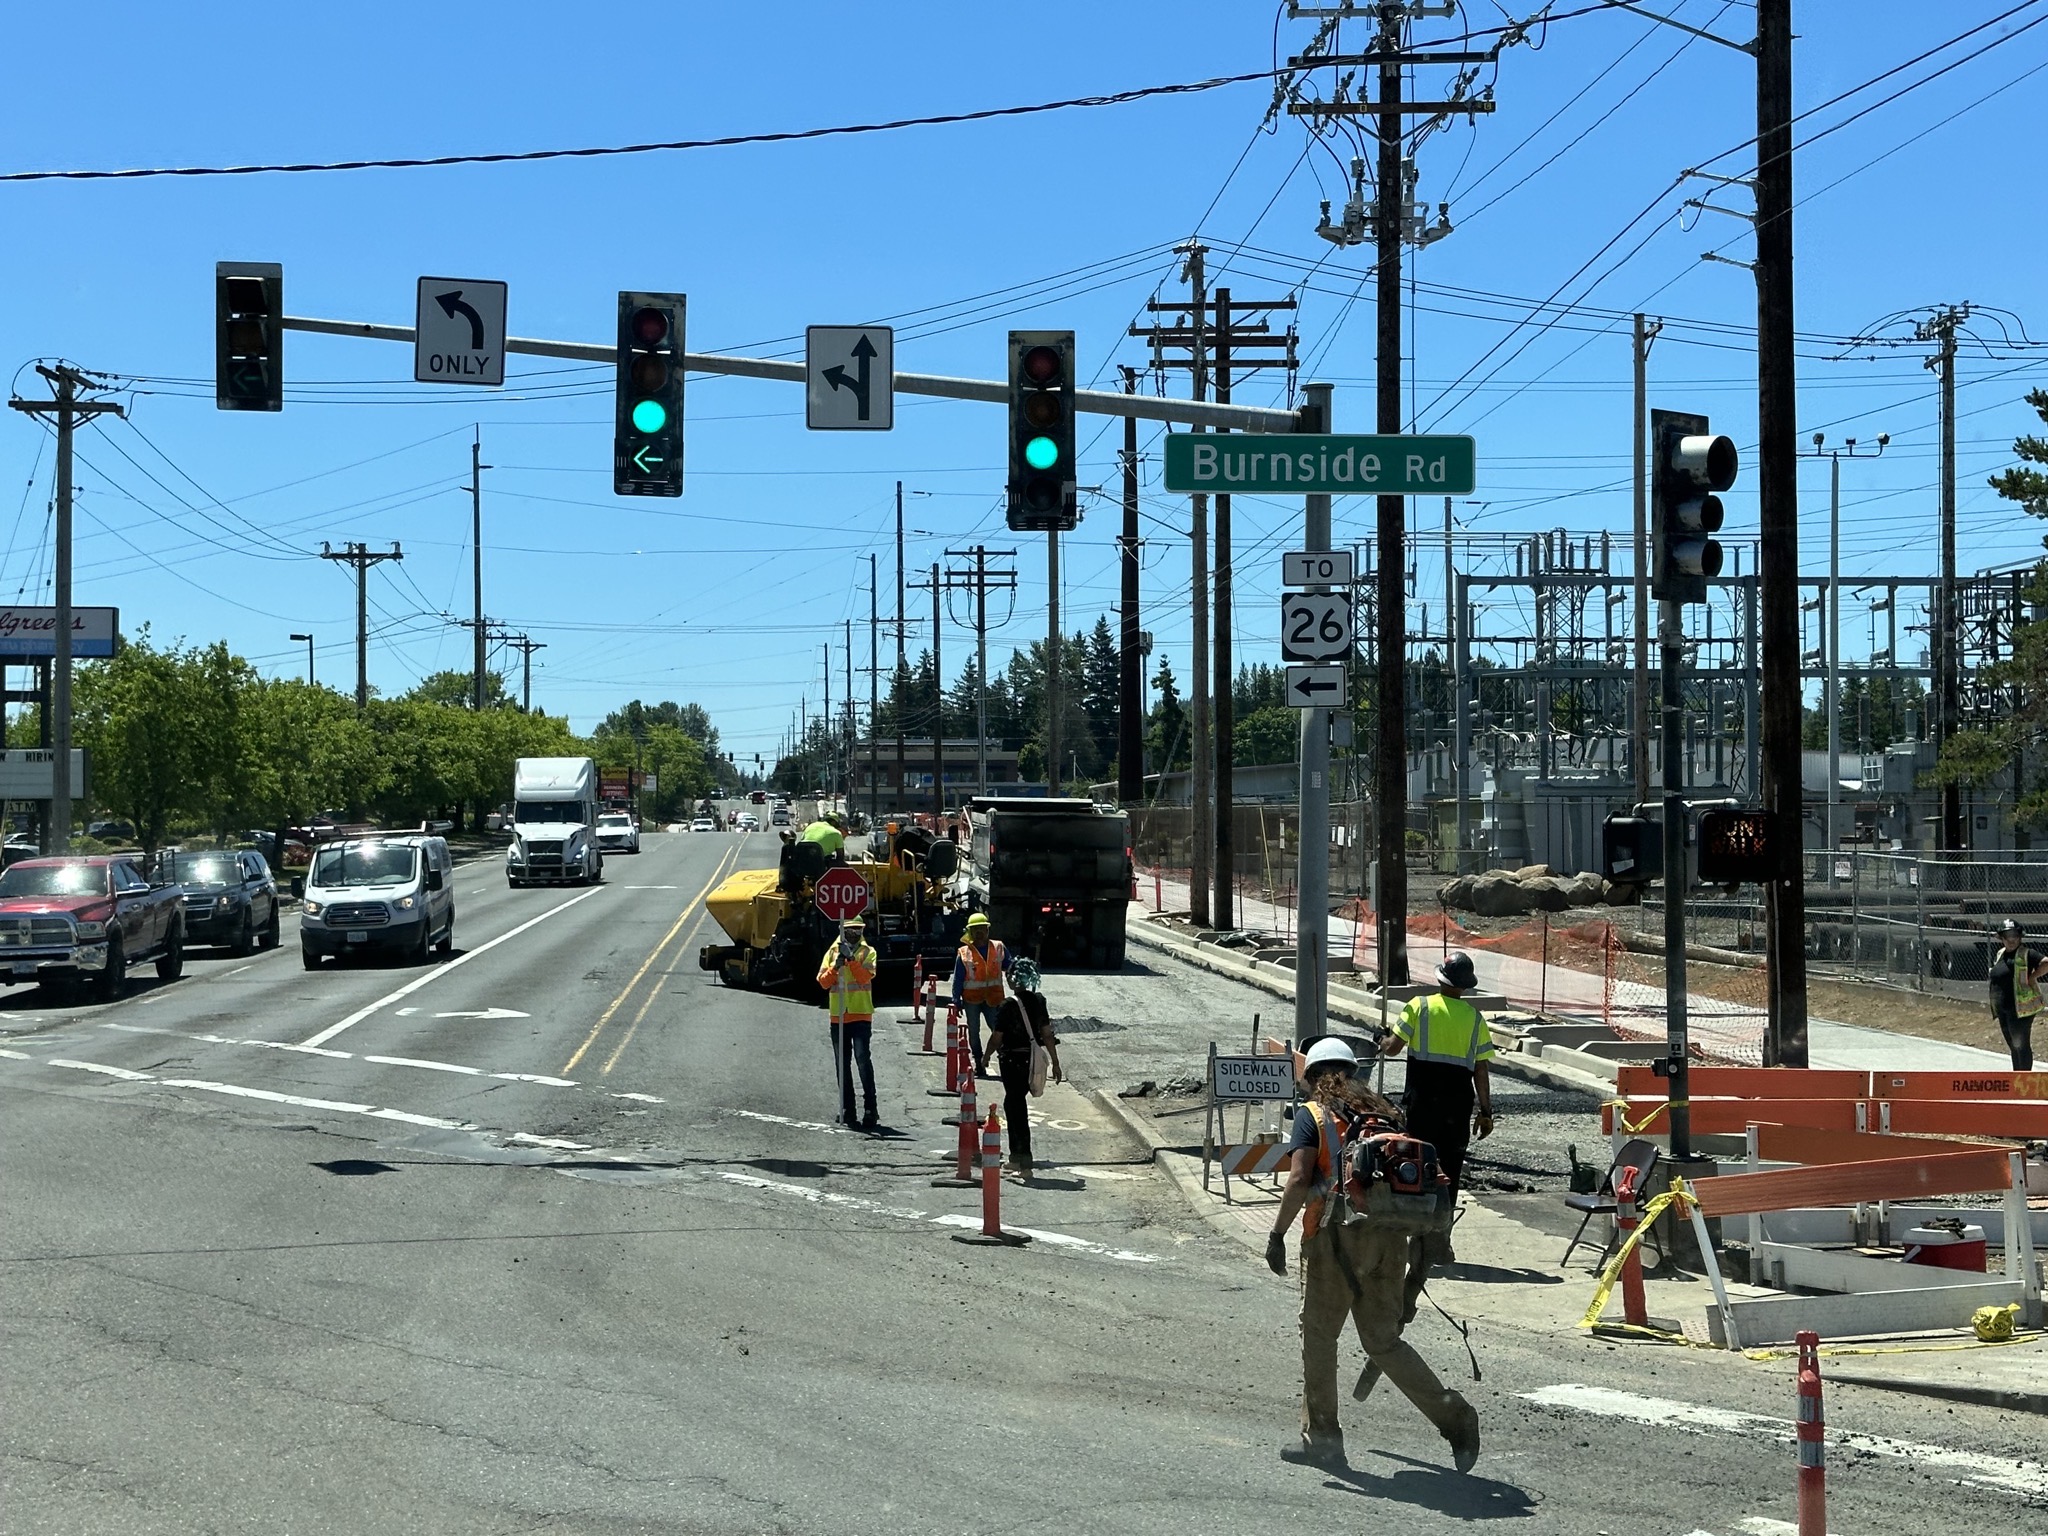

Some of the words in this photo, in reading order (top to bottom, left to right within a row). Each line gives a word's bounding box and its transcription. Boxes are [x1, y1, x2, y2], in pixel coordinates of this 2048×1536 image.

[430, 354, 490, 375] ONLY
[1193, 444, 1382, 483] Burnside
[1406, 455, 1446, 482] Rd
[1301, 560, 1334, 578] TO
[0, 612, 86, 637] lgrees
[1290, 607, 1344, 643] 26
[25, 752, 54, 762] HIRIN
[9, 802, 35, 812] ATM
[819, 885, 866, 904] STOP
[1221, 1063, 1287, 1077] SIDEWALK
[1228, 1080, 1280, 1094] CLOSED
[1952, 1080, 2010, 1092] RAIMORE
